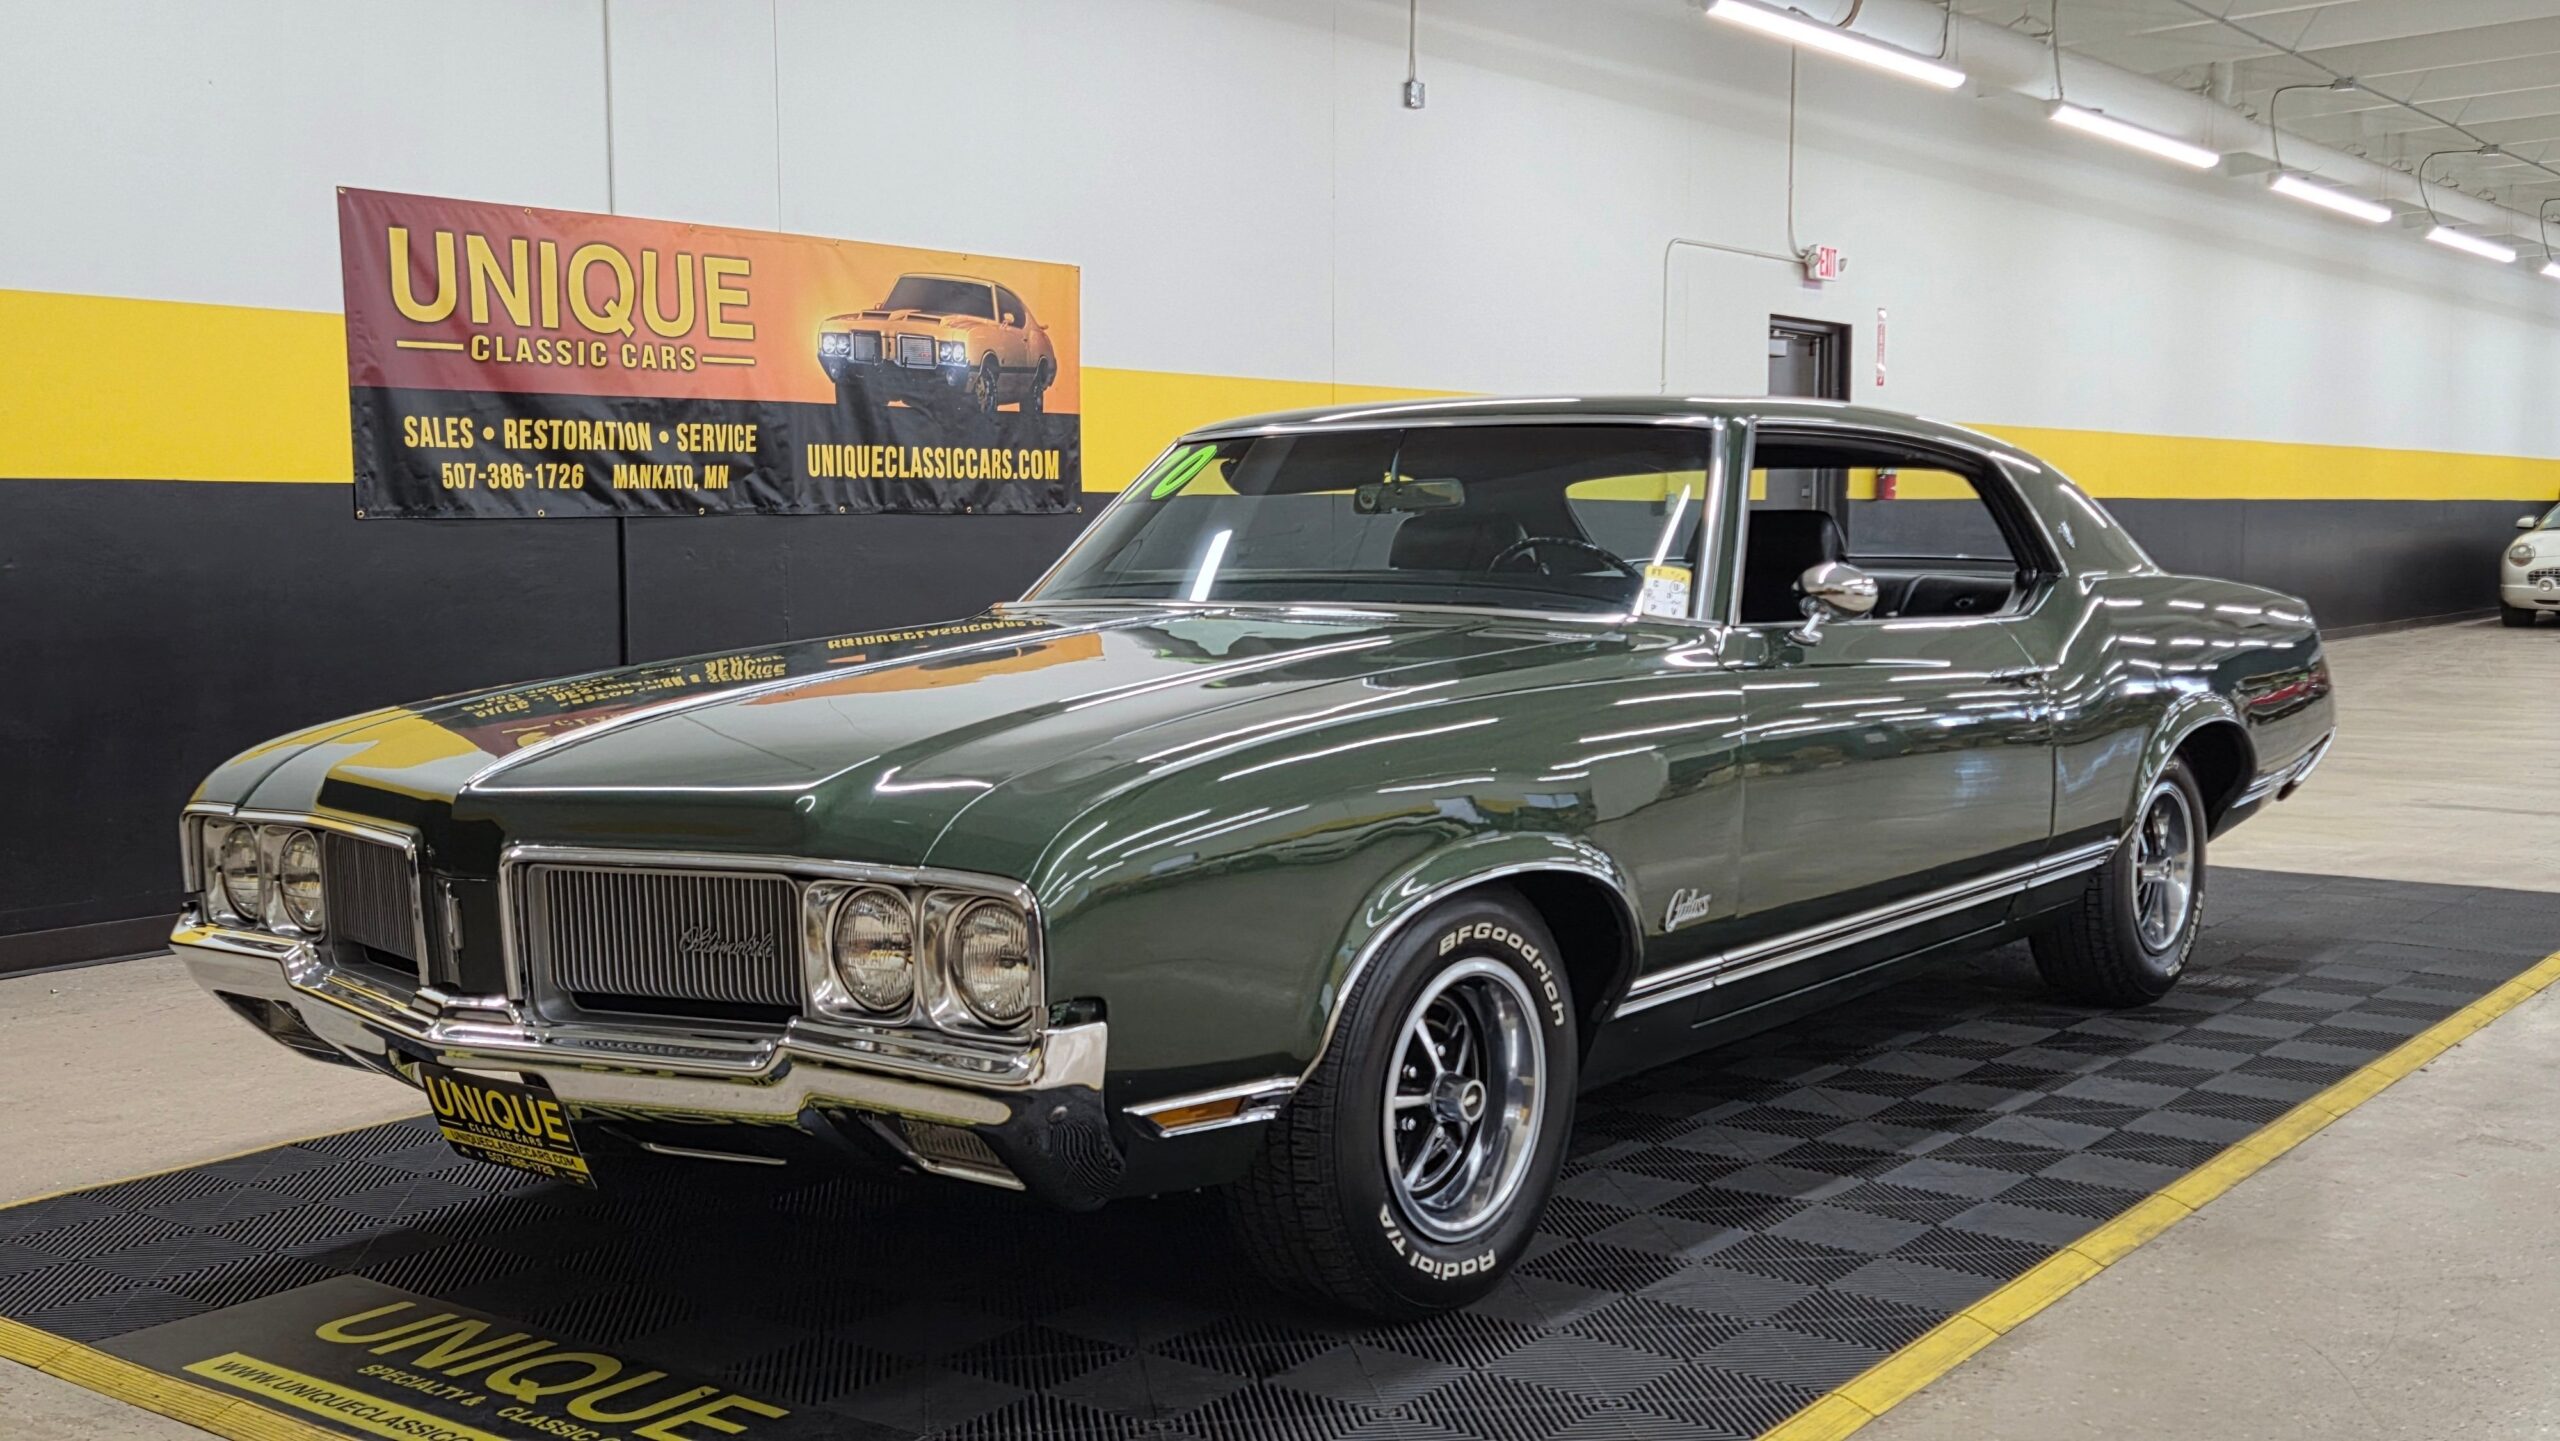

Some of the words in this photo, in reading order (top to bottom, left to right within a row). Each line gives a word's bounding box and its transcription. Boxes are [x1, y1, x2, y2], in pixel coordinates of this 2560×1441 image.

[1818, 247, 1837, 277] EXIT
[388, 227, 755, 338] UNIQUE
[471, 335, 608, 367] CLASSIC
[622, 343, 697, 371] CARS
[404, 416, 475, 449] SALES
[503, 419, 653, 451] RESTORATION
[676, 424, 758, 453] SERVICE
[442, 463, 585, 490] 507-386-1726
[612, 464, 699, 492] MANKATO,
[703, 465, 729, 490] MN
[807, 444, 1060, 480] UNIQUECLASSICCARS.COM
[1438, 922, 1565, 1027] BFGoodrich
[425, 1075, 570, 1142] UNIQUE
[468, 1122, 512, 1141] CLASSIC
[514, 1133, 543, 1147] CARS
[1409, 1248, 1497, 1280] Radial
[315, 1301, 791, 1441] UNIQUE
[357, 1365, 474, 1399] SPECIALTY
[496, 1407, 600, 1441] CLASSIC
